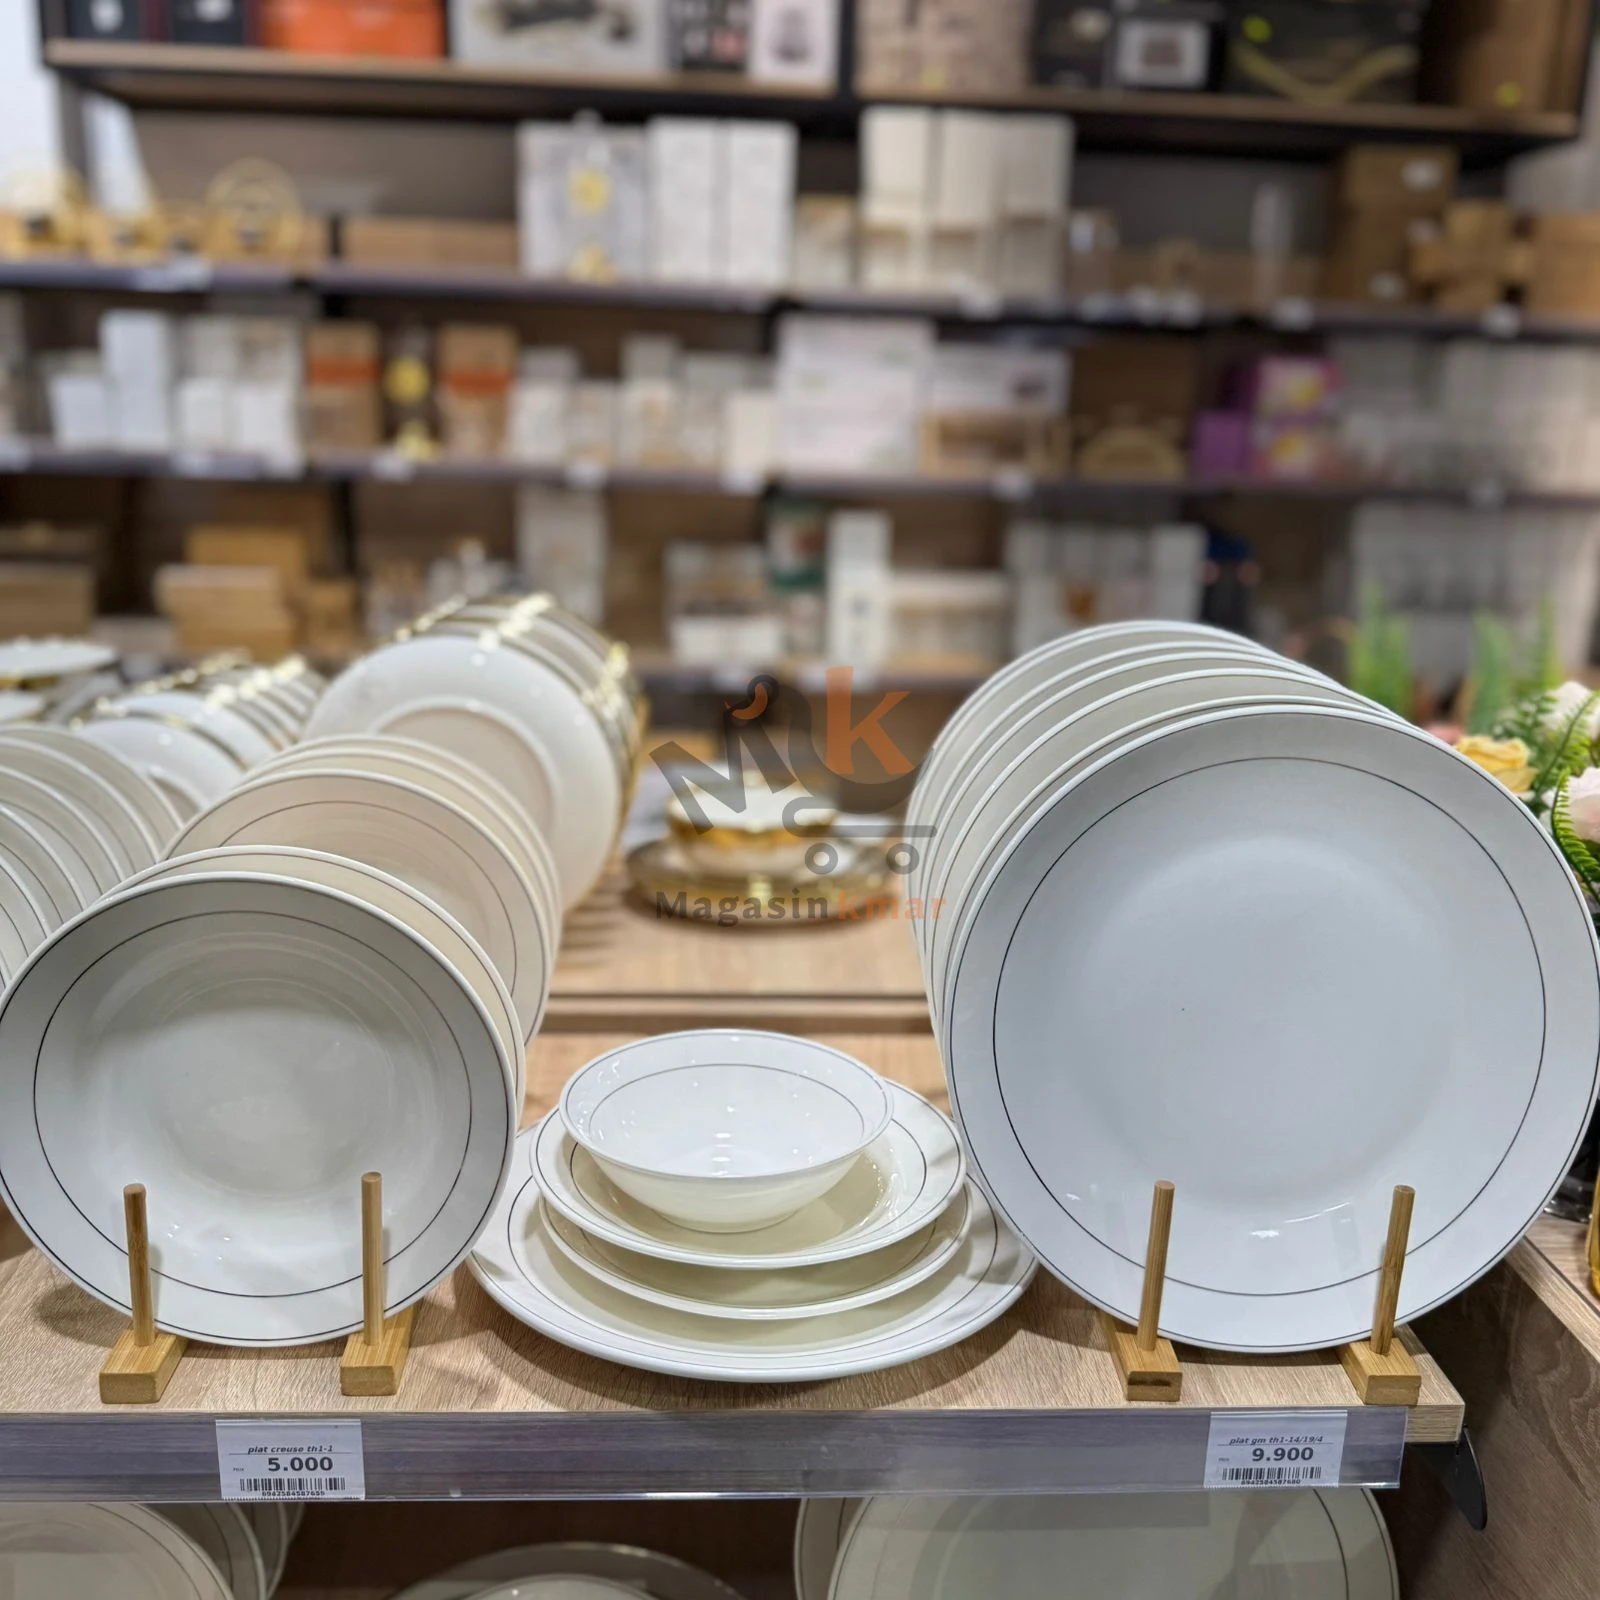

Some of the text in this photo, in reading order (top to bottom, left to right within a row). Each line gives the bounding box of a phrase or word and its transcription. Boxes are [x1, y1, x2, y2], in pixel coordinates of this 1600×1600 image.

[248, 1446, 268, 1455] plat
[307, 1445, 333, 1453] th1-1
[1252, 1447, 1314, 1461] 9.900
[268, 1456, 333, 1472] 5.000
